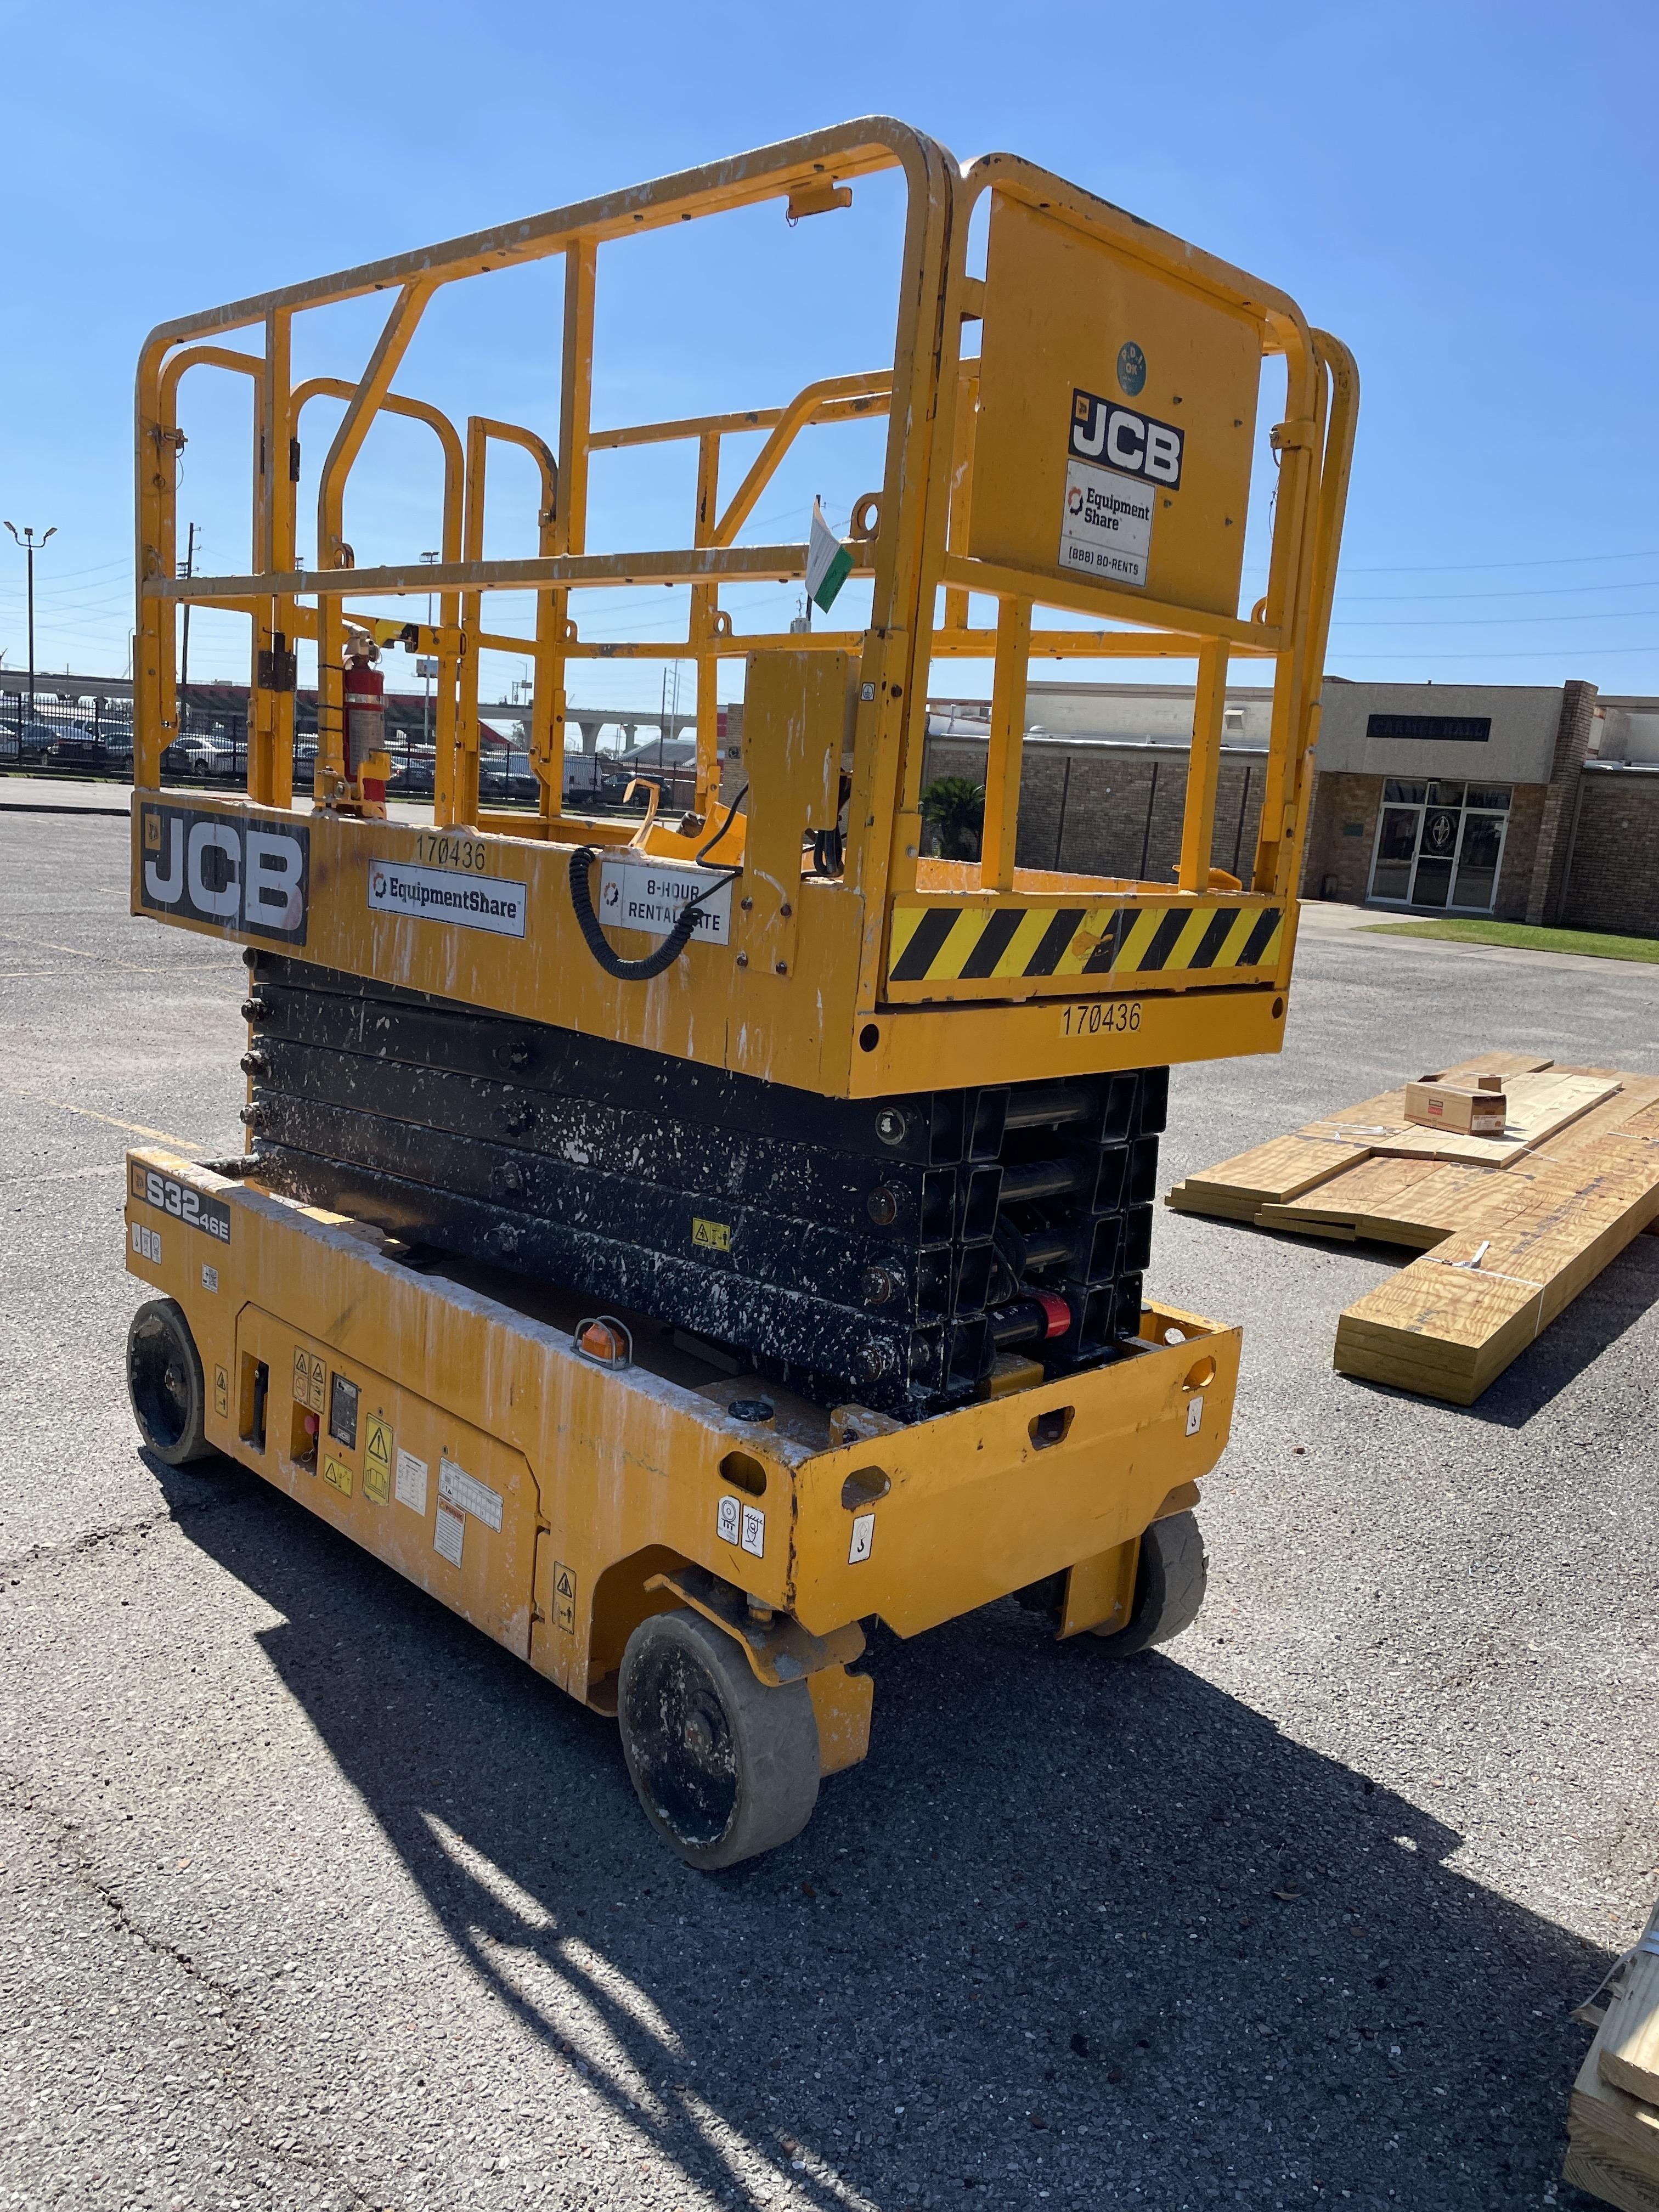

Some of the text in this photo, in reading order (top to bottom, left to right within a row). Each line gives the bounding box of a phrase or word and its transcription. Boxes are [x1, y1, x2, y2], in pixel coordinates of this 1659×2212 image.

[1125, 362, 1138, 375] OK
[1073, 403, 1180, 483] JCB
[1084, 507, 1119, 531] Share
[1087, 487, 1149, 521] Equipment
[1069, 546, 1094, 565] (888)
[417, 833, 486, 871] 170436
[145, 817, 303, 930] JCB
[390, 876, 517, 919] EquipmentShare
[647, 880, 699, 901] 8-HOUR
[629, 902, 679, 924] RENTAL
[1064, 1002, 1141, 1035] 170436
